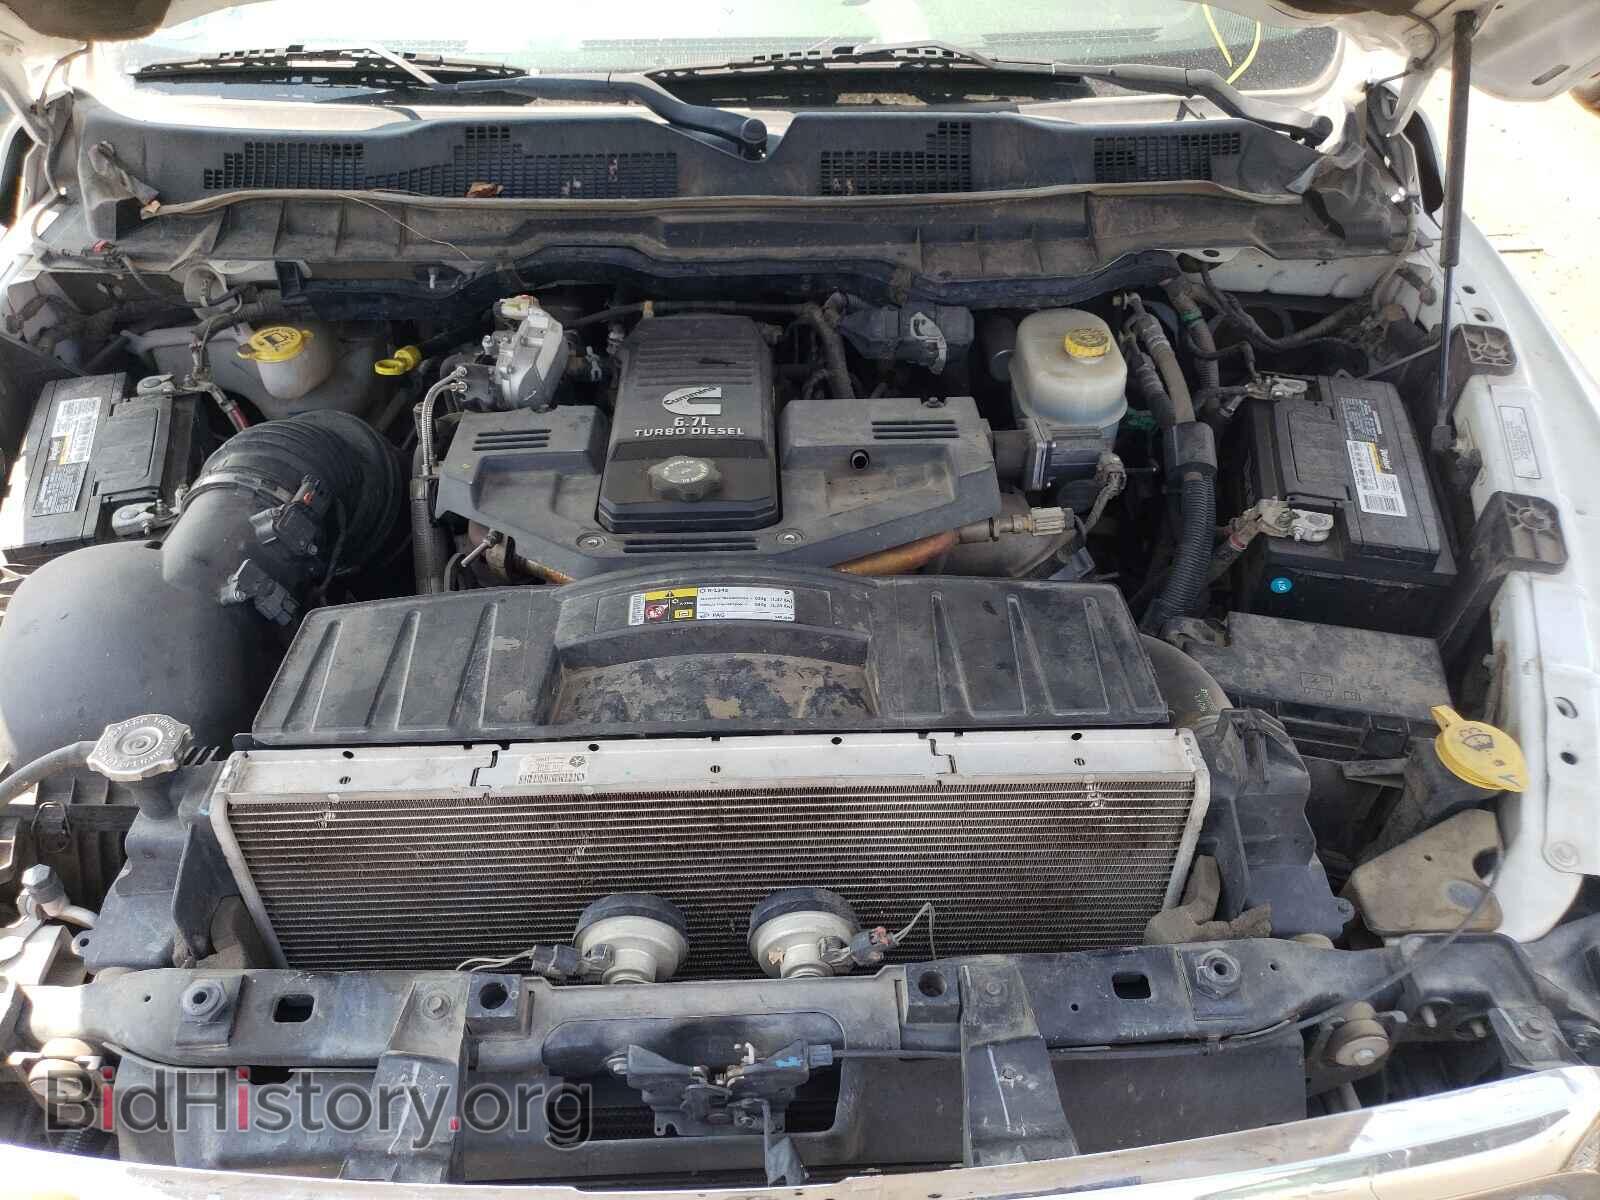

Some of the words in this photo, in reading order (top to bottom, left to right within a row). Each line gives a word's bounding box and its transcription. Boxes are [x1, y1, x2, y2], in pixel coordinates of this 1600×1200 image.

[664, 386, 717, 405] Cummins
[674, 416, 710, 427] 6.7L
[634, 427, 686, 437] TURBO
[691, 427, 745, 436] DIESEL
